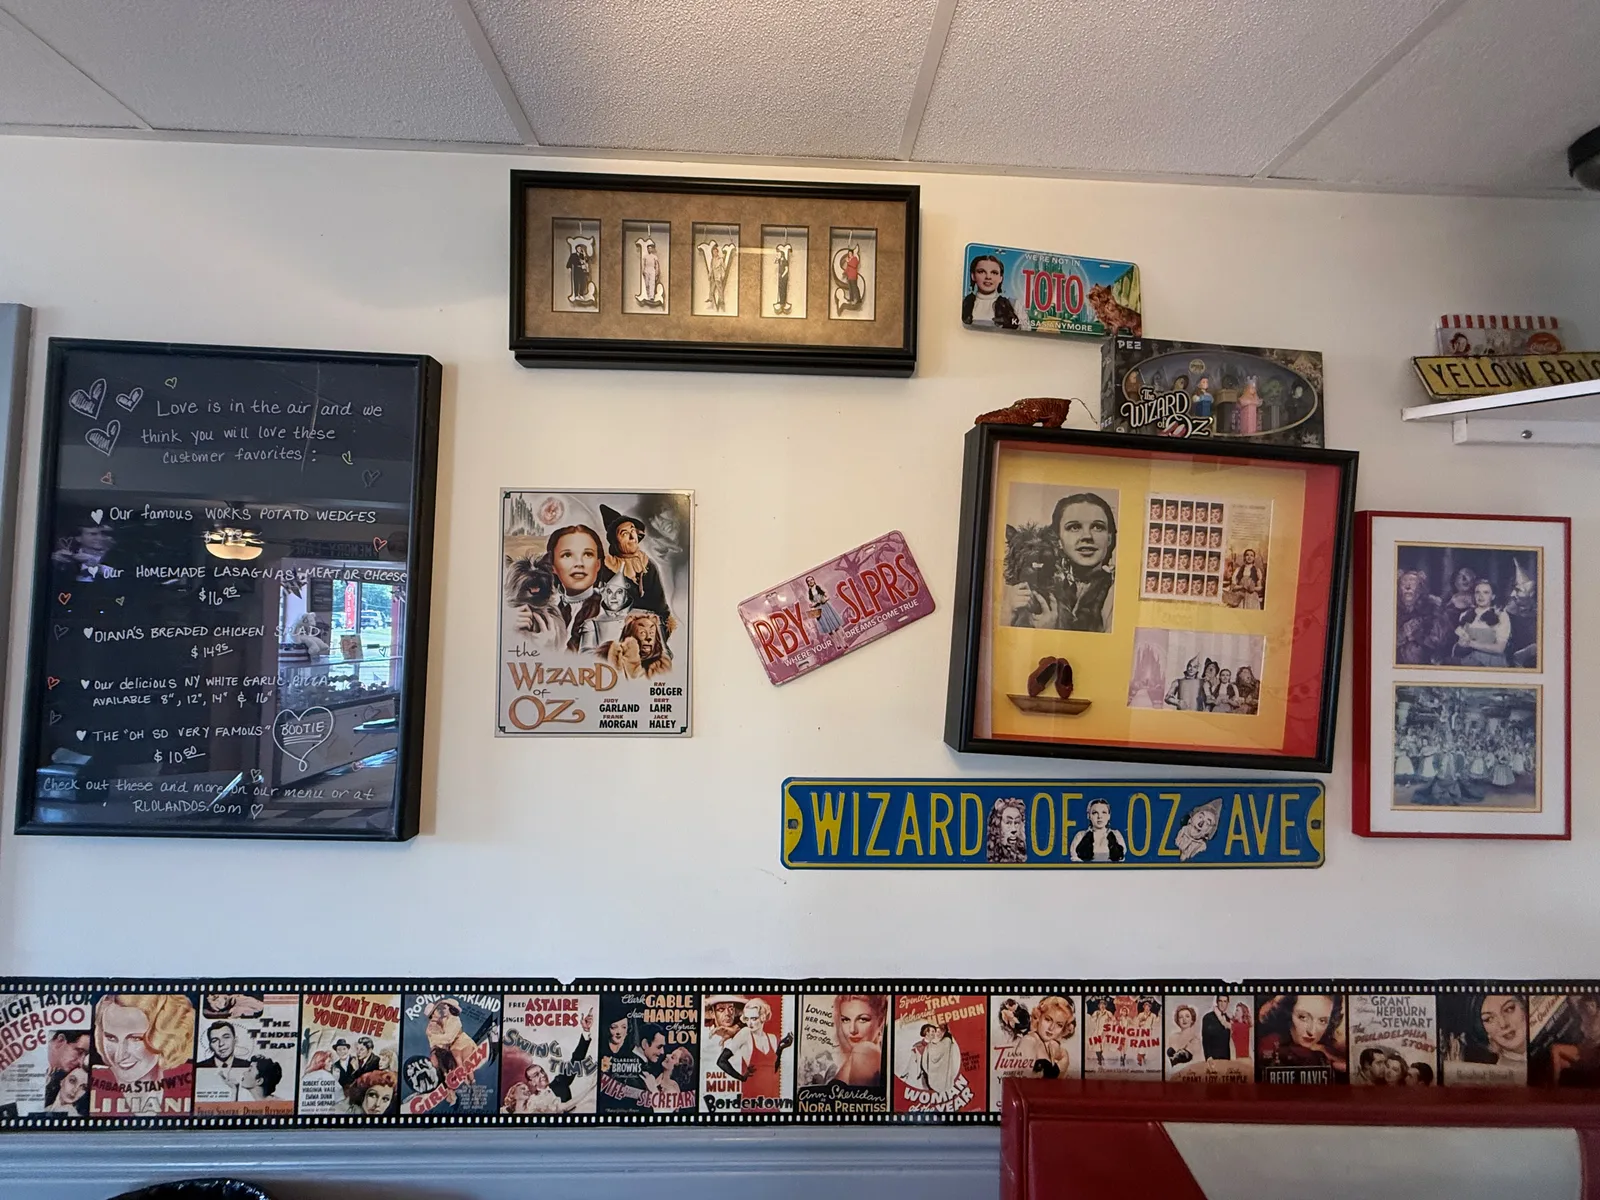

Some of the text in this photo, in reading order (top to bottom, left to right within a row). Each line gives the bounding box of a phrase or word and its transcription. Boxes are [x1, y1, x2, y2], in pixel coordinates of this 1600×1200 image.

[1052, 257, 1068, 265] NOT
[1071, 259, 1080, 267] IN
[1022, 269, 1084, 315] TOTO
[1011, 318, 1093, 332] KANSAS ANYMORE
[1117, 340, 1142, 350] PEZ
[1428, 361, 1537, 388] YELLOW
[157, 399, 382, 417] Love is in the air and we
[1120, 392, 1188, 428] WIZARD
[141, 426, 336, 445] think you will love these
[110, 504, 376, 524] Our famous WORKS POTATO WEDGES
[136, 565, 360, 580] HOMEMADE MEAT OR
[835, 553, 920, 625] SLPRS
[94, 626, 145, 643] DIANA'S
[150, 626, 208, 639] BREADED
[213, 625, 264, 637] CHICKEN
[752, 602, 811, 663] RBY
[784, 598, 920, 667] WHERE YOUR DREAMS COME TRUE
[508, 642, 540, 657] the
[119, 675, 284, 690] delicious NY WHITE GARLIC
[507, 662, 618, 692] WIZARD
[533, 688, 551, 696] of
[649, 687, 683, 696] BOLGER
[92, 695, 151, 706] AVAILABLE
[599, 703, 640, 713] GARLAND
[649, 703, 672, 713] LAHR
[509, 695, 585, 730] OZ
[280, 721, 324, 736] BOOTIE
[599, 719, 638, 729] MORGAN
[649, 719, 676, 729] HALEY
[92, 730, 119, 742] THE
[152, 729, 168, 739] SO
[178, 727, 210, 739] VERY
[43, 778, 375, 800] Check out these and more on our menu or at
[810, 792, 1300, 857] WIZARD OF OZ AVE
[305, 994, 333, 1007] YOU
[369, 1002, 401, 1023] FOOL
[453, 994, 501, 1013] ARLAND
[525, 998, 579, 1012] ASTAIRE
[645, 994, 694, 1008] GABLE
[925, 995, 961, 1010] TRACY
[1371, 996, 1411, 1006] GRANT
[643, 1009, 698, 1023] HARLOW
[805, 1003, 833, 1019] LOVING
[927, 1003, 985, 1025] HEPBURN
[1376, 1006, 1426, 1017] HEPBURN
[260, 1018, 291, 1028] THE
[313, 1008, 385, 1037] YOUR WIFE
[525, 1012, 579, 1027] ROGERS
[805, 1016, 835, 1027] HER ONCE
[1382, 1018, 1433, 1028] STEWART
[0, 1007, 85, 1050] ATERLOO
[247, 1029, 299, 1038] TENDER
[257, 1040, 295, 1049] TRAP
[502, 1028, 562, 1058] SWING
[668, 1031, 698, 1045] LOY
[1089, 1034, 1160, 1048] IN THE RAIN
[994, 1046, 1035, 1070] Turner
[549, 1055, 598, 1077] TIME
[409, 1083, 449, 1114] GIRL
[445, 1042, 489, 1090] CRAZY
[706, 1071, 727, 1079] PAUL
[1300, 1070, 1328, 1085] DAVIS
[706, 1080, 740, 1092] MUNI
[828, 1084, 885, 1102] Sheridan
[904, 1074, 969, 1104] WOMAN
[798, 1100, 887, 1113] NORA PRENTISS
[935, 1087, 974, 1113] YEAR
